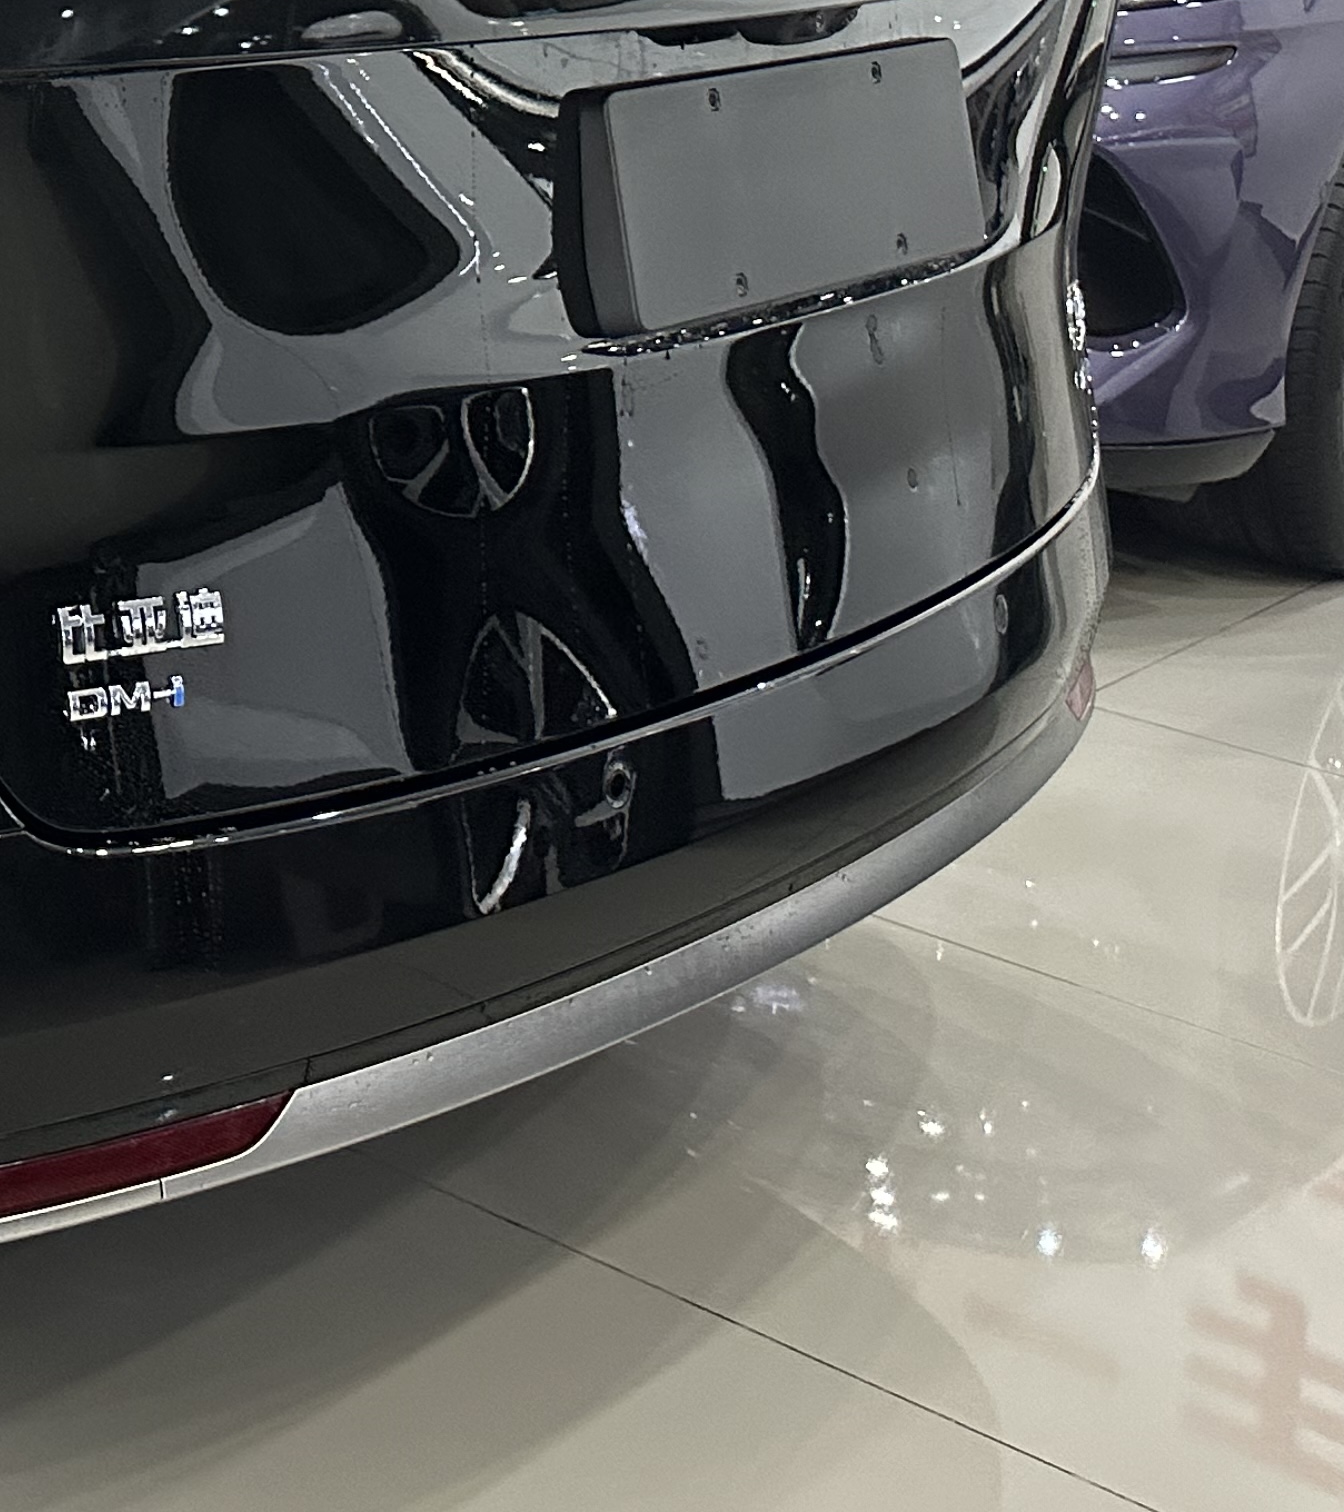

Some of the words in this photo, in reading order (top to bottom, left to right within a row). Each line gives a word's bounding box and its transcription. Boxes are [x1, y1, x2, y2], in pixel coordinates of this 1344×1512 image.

[56, 587, 225, 665] 比亚迪
[67, 674, 186, 723] DM-i
